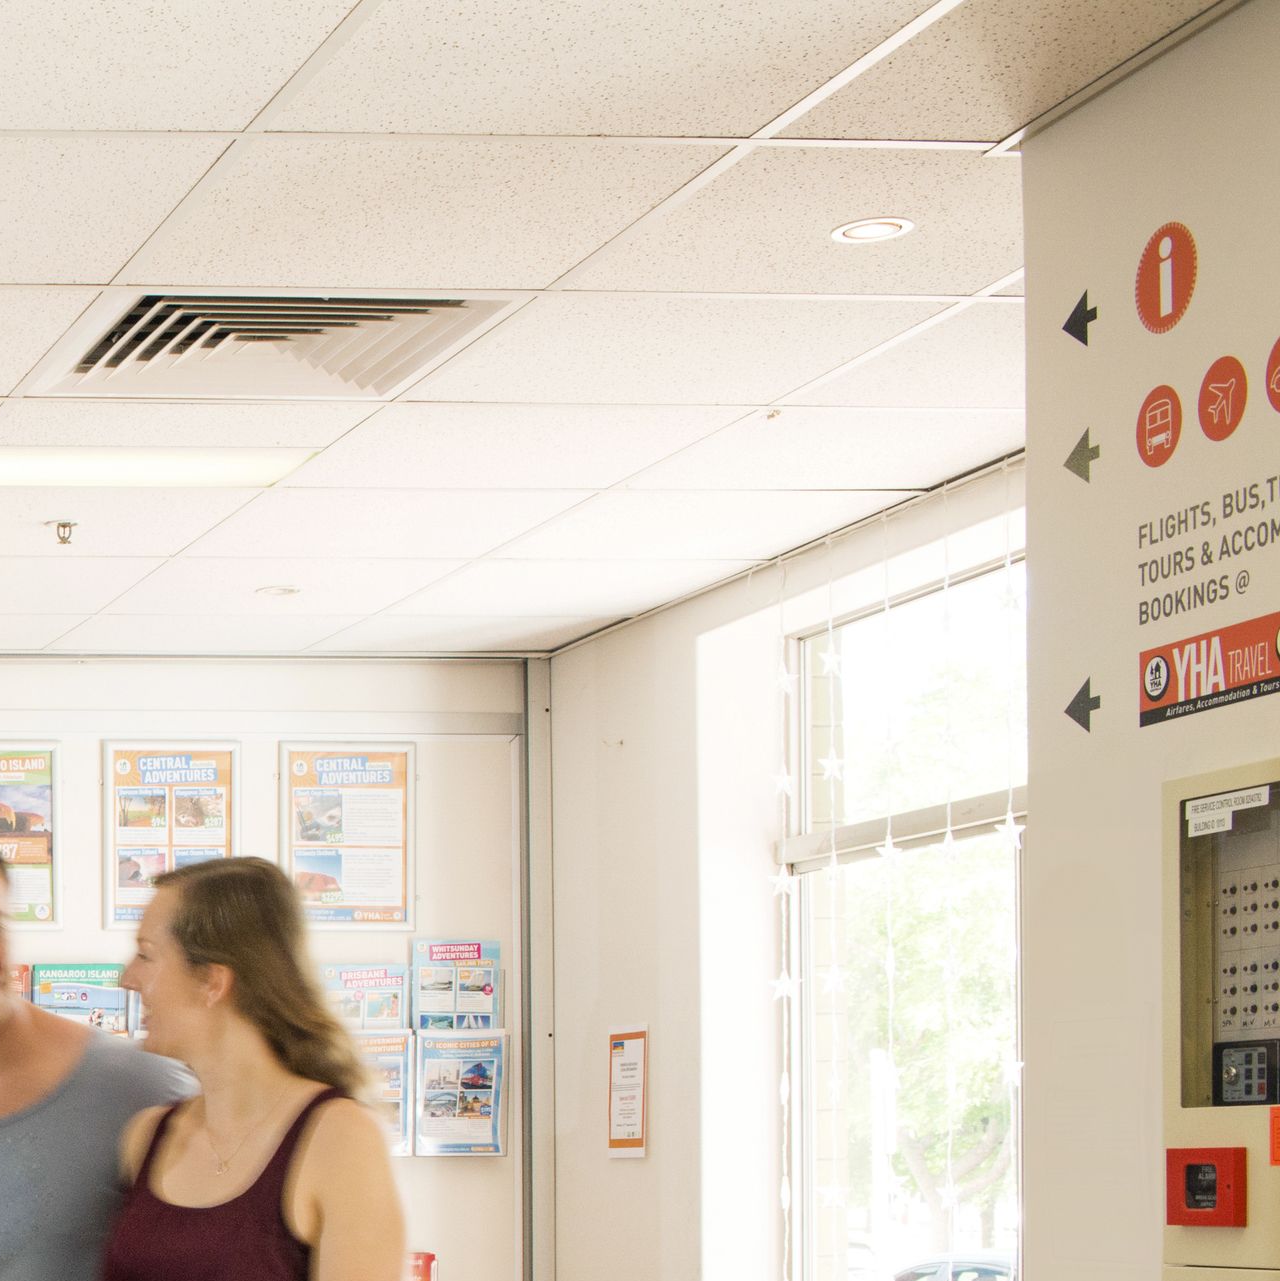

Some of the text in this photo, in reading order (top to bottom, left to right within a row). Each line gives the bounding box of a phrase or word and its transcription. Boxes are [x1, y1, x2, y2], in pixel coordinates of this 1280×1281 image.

[1139, 500, 1217, 550] FLIGHTS,
[1138, 546, 1196, 587] TOURS
[1200, 540, 1214, 567] &
[1139, 569, 1250, 626] BOOKINGS @
[1171, 635, 1273, 703] YHA TRAVEL
[1165, 680, 1280, 718] Airfares, Accommodation & Tours
[9, 758, 46, 771] ISLAND
[139, 757, 189, 771] CENTRAL
[316, 759, 365, 772] CENTRAL
[144, 768, 216, 784] ADVENTURES
[320, 770, 391, 786] ADVENTURES
[431, 944, 479, 954] WHITSUNDAY
[431, 951, 480, 960] ADVENTURES
[39, 969, 120, 979] KANGAROO ISLAND
[341, 969, 387, 980] BRISBANE
[345, 977, 403, 989] ADVENTURES
[435, 1042, 459, 1050] ICONIC
[459, 1041, 480, 1049] CITIES
